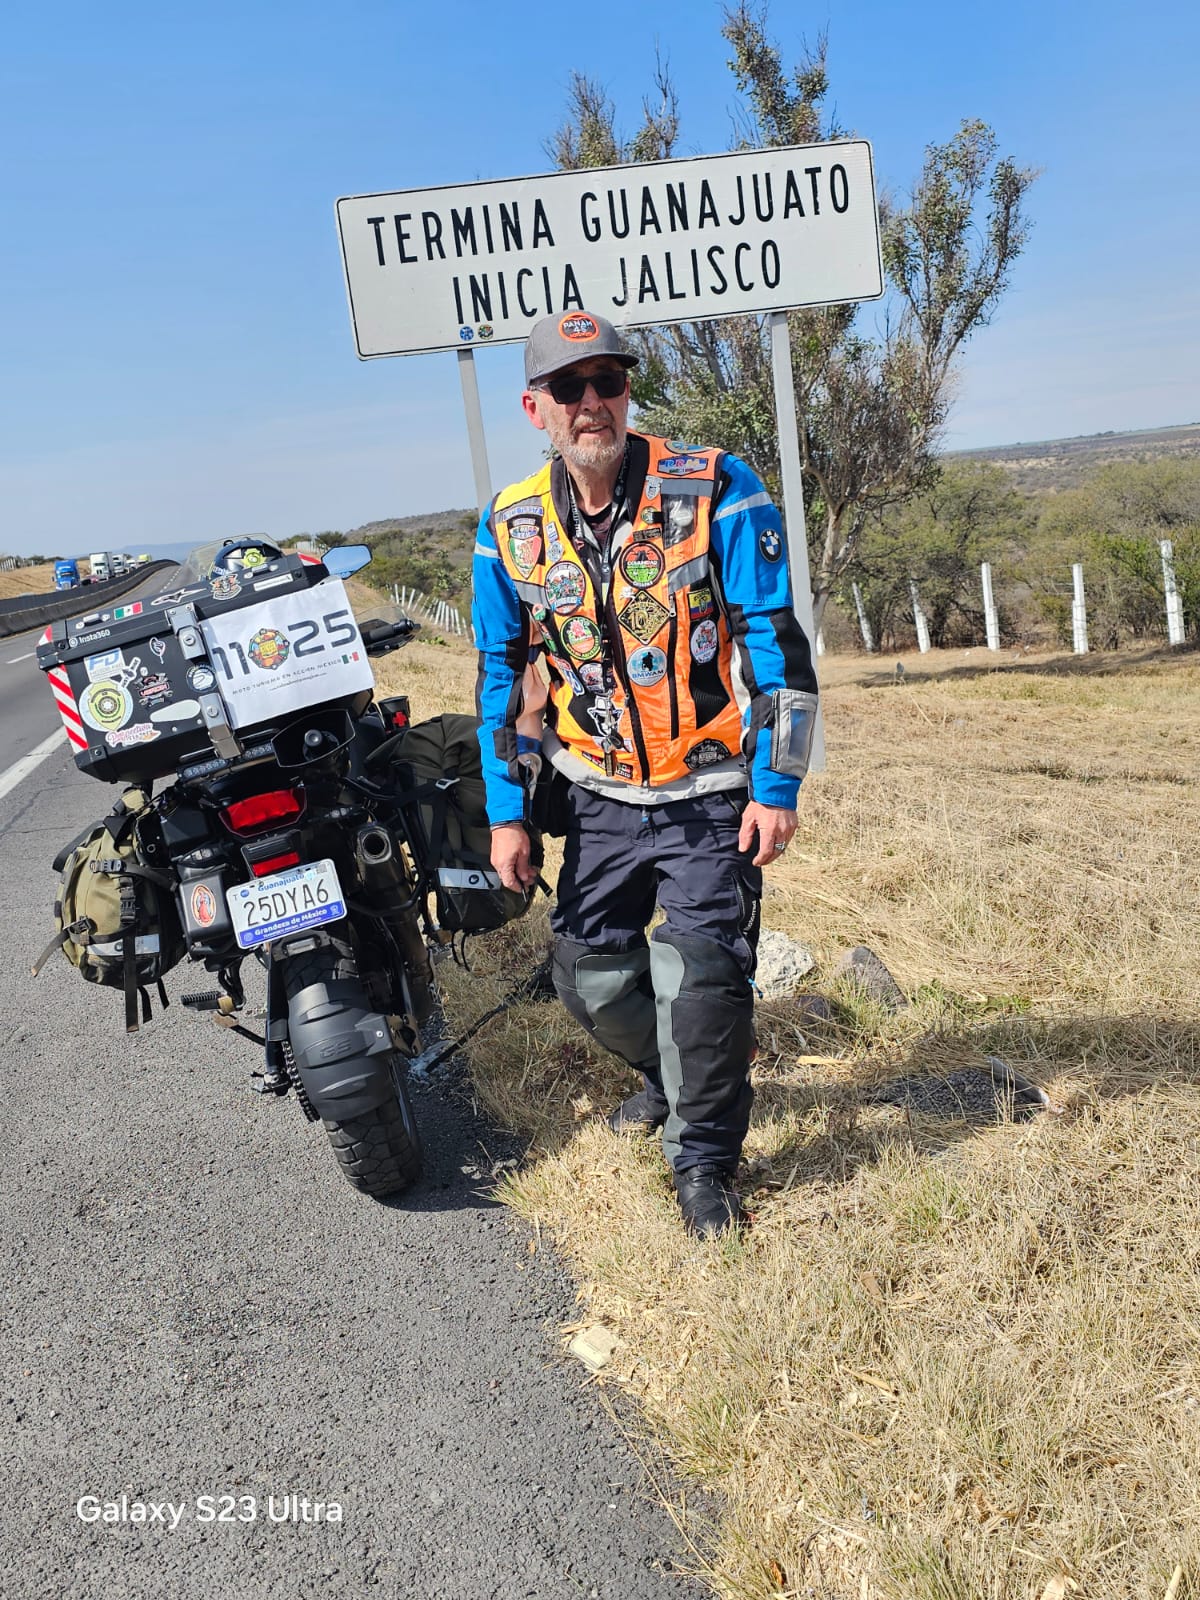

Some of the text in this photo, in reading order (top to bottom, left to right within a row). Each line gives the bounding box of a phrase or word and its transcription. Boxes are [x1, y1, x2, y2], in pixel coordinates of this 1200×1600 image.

[367, 163, 850, 266] TERMINA GUANAJUATO
[452, 239, 782, 325] INICIA JALISCO
[80, 629, 111, 644] Insta360
[632, 670, 664, 679] BMWAM
[232, 686, 251, 694] MOTO
[257, 874, 305, 892] Guanajuato
[243, 878, 329, 927] 25DYA6
[254, 921, 290, 937] Grandeza
[290, 916, 301, 925] de
[301, 908, 328, 922] México
